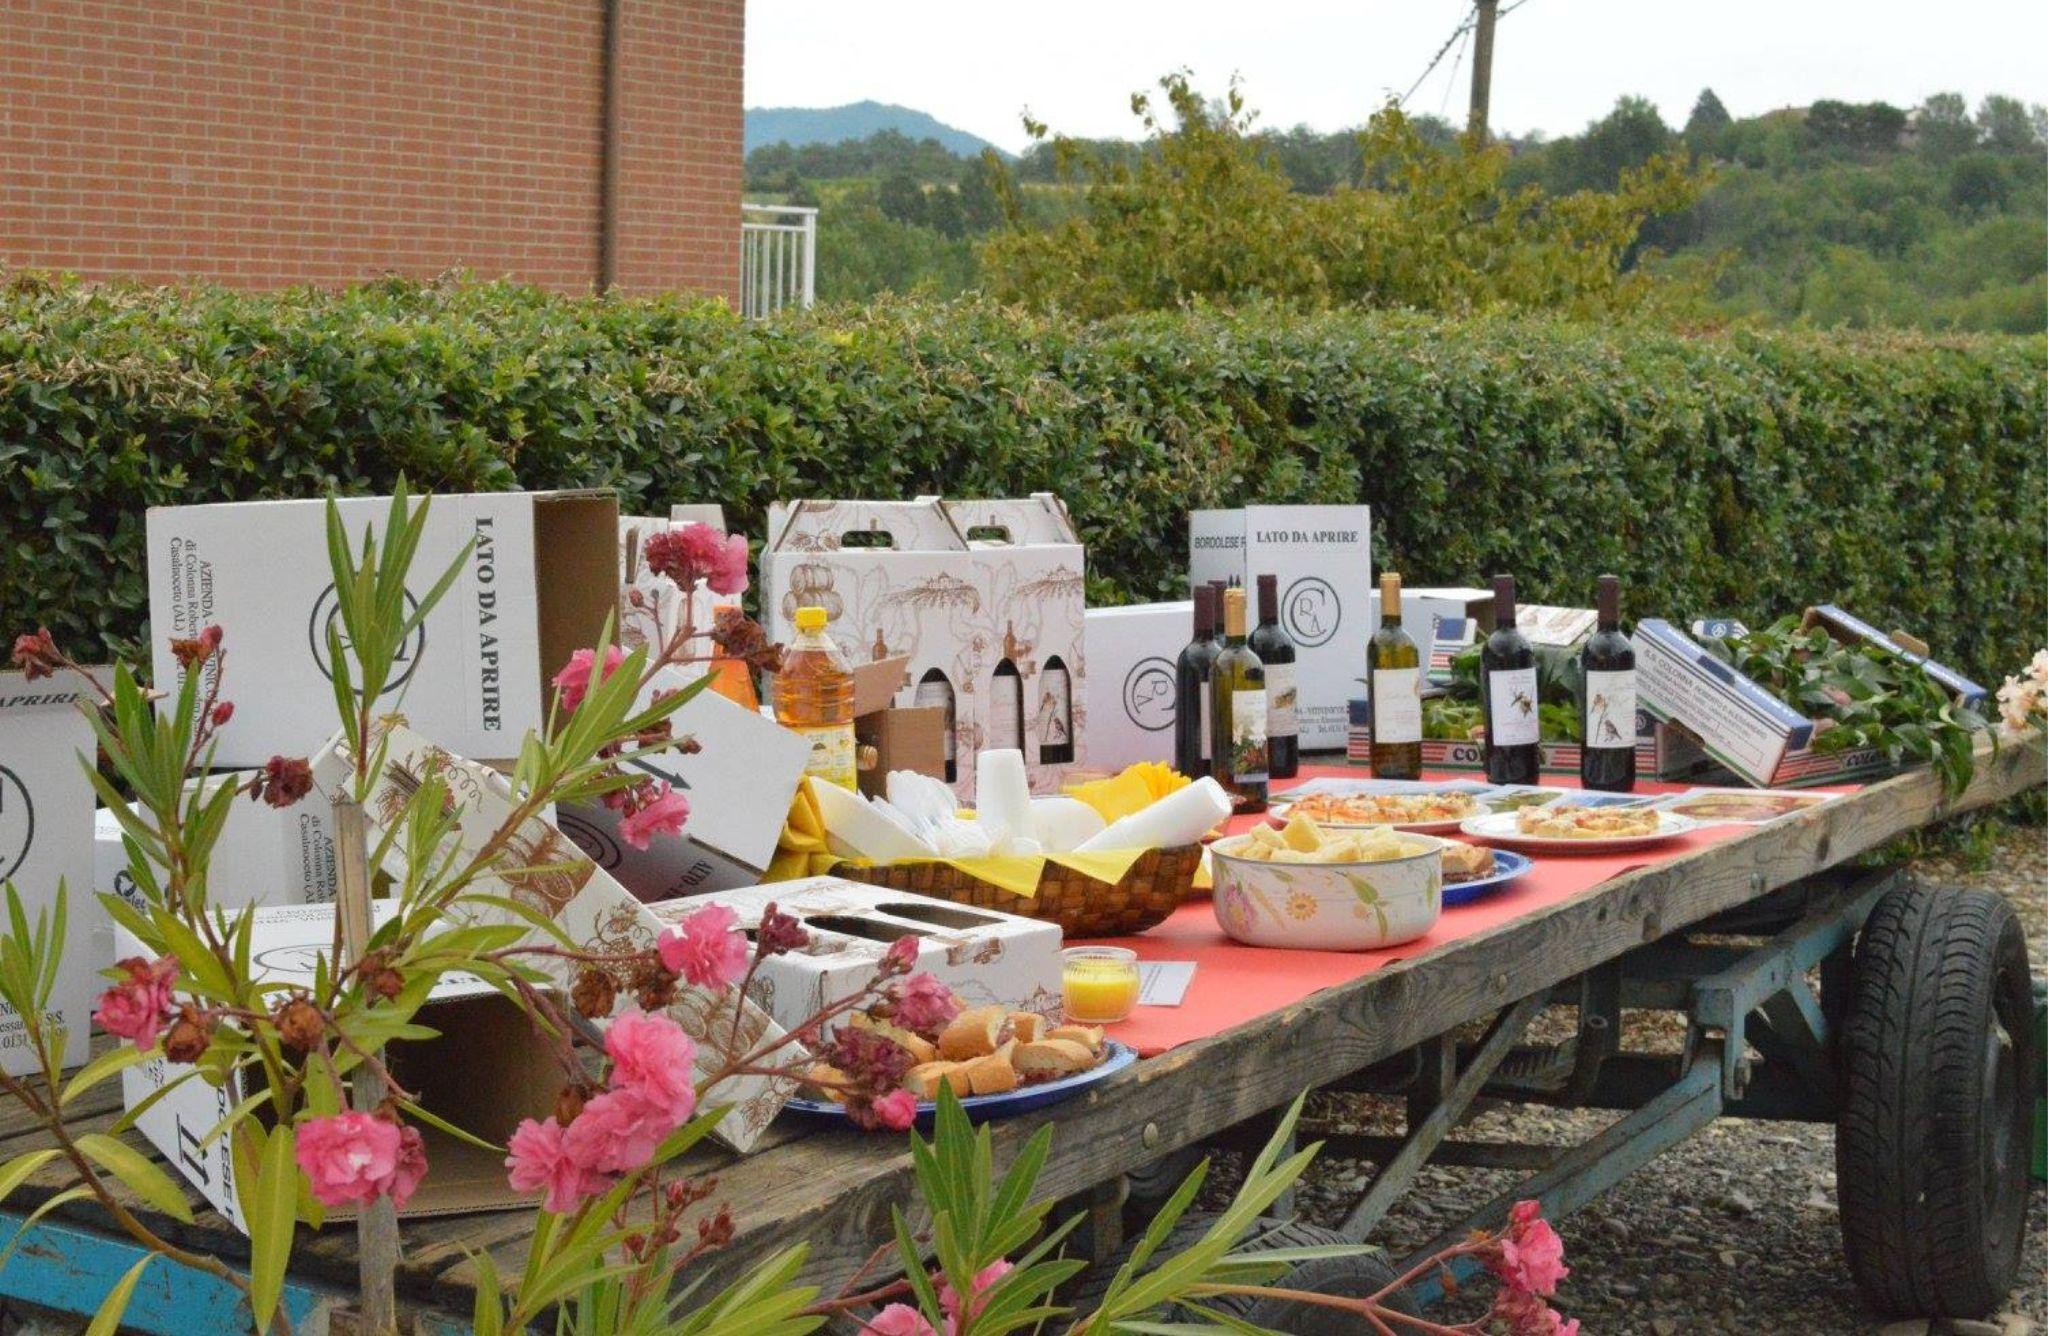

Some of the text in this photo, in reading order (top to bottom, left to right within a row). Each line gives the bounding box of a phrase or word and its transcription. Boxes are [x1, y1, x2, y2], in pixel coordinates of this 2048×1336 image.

[1256, 530, 1289, 543] LATO
[1291, 530, 1308, 543] DA
[1311, 530, 1360, 543] APRIRE
[170, 537, 185, 631] Casalnoceto (AL)
[185, 540, 199, 639] di Colonna Robert
[200, 560, 213, 618] AZIENDA
[475, 517, 501, 736] LATO DA APRIRE
